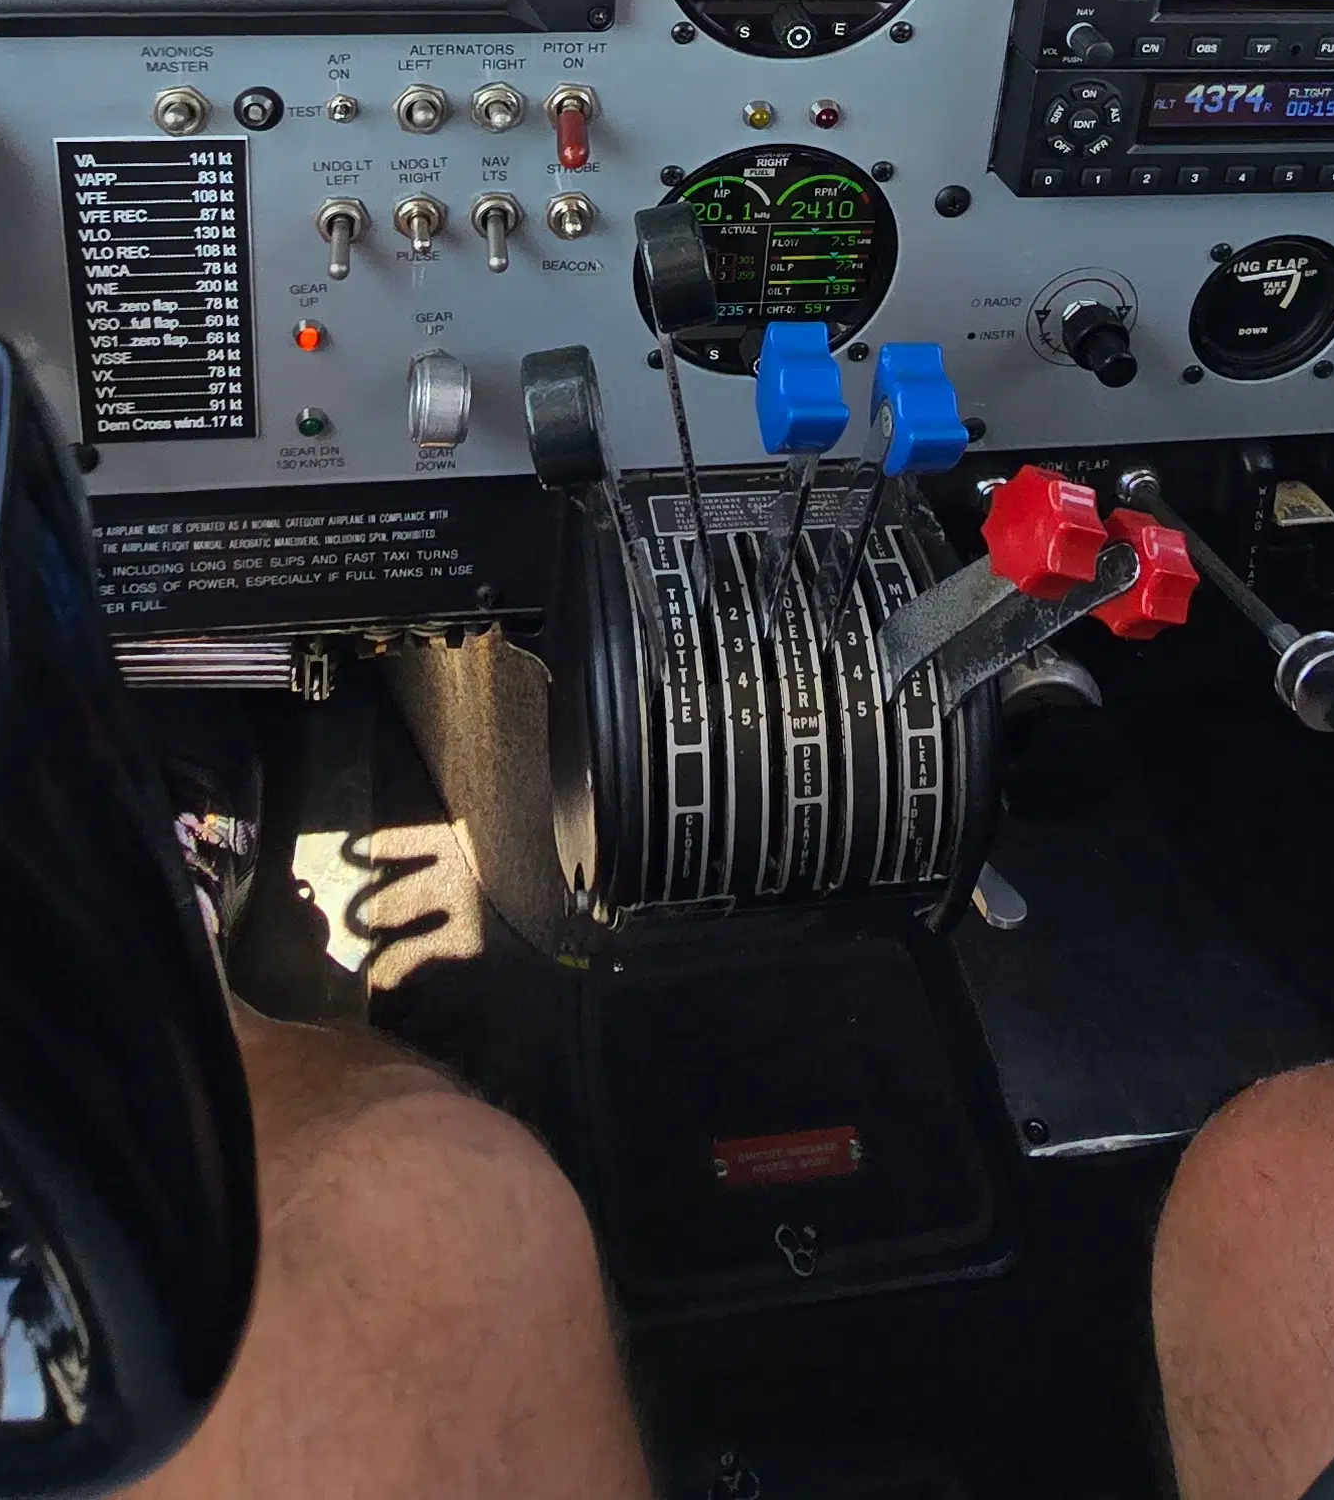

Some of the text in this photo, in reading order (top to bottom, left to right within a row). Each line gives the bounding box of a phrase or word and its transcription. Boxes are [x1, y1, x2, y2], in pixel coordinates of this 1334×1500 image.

[141, 47, 214, 58] AVIONICS
[410, 44, 514, 56] ALTERNATORS
[543, 42, 606, 54] PITOT HT
[146, 62, 208, 73] MASTER
[397, 60, 433, 71] LEFT
[481, 59, 526, 70] RIGHT
[1184, 85, 1266, 111] 4374
[1288, 88, 1330, 99] FLIGHT
[288, 106, 323, 117] TEST
[757, 158, 788, 168] RIGHT
[815, 187, 837, 197] RPM
[791, 200, 854, 220] 2410
[772, 238, 799, 247] FLOW
[542, 260, 597, 272] BEACON
[87, 282, 119, 294] VNE
[197, 278, 238, 292] 200 kt
[983, 297, 1022, 307] RADIO
[416, 312, 452, 323] GEAR
[980, 329, 1016, 339] INSTR
[1238, 327, 1268, 335] DOWN
[416, 460, 456, 471] DOWN
[113, 548, 458, 576] INCLUDING LONG SIDE SLIPS AND FAST TAXI TURNS
[666, 588, 692, 724] THROTTLE
[793, 715, 818, 728] RPM
